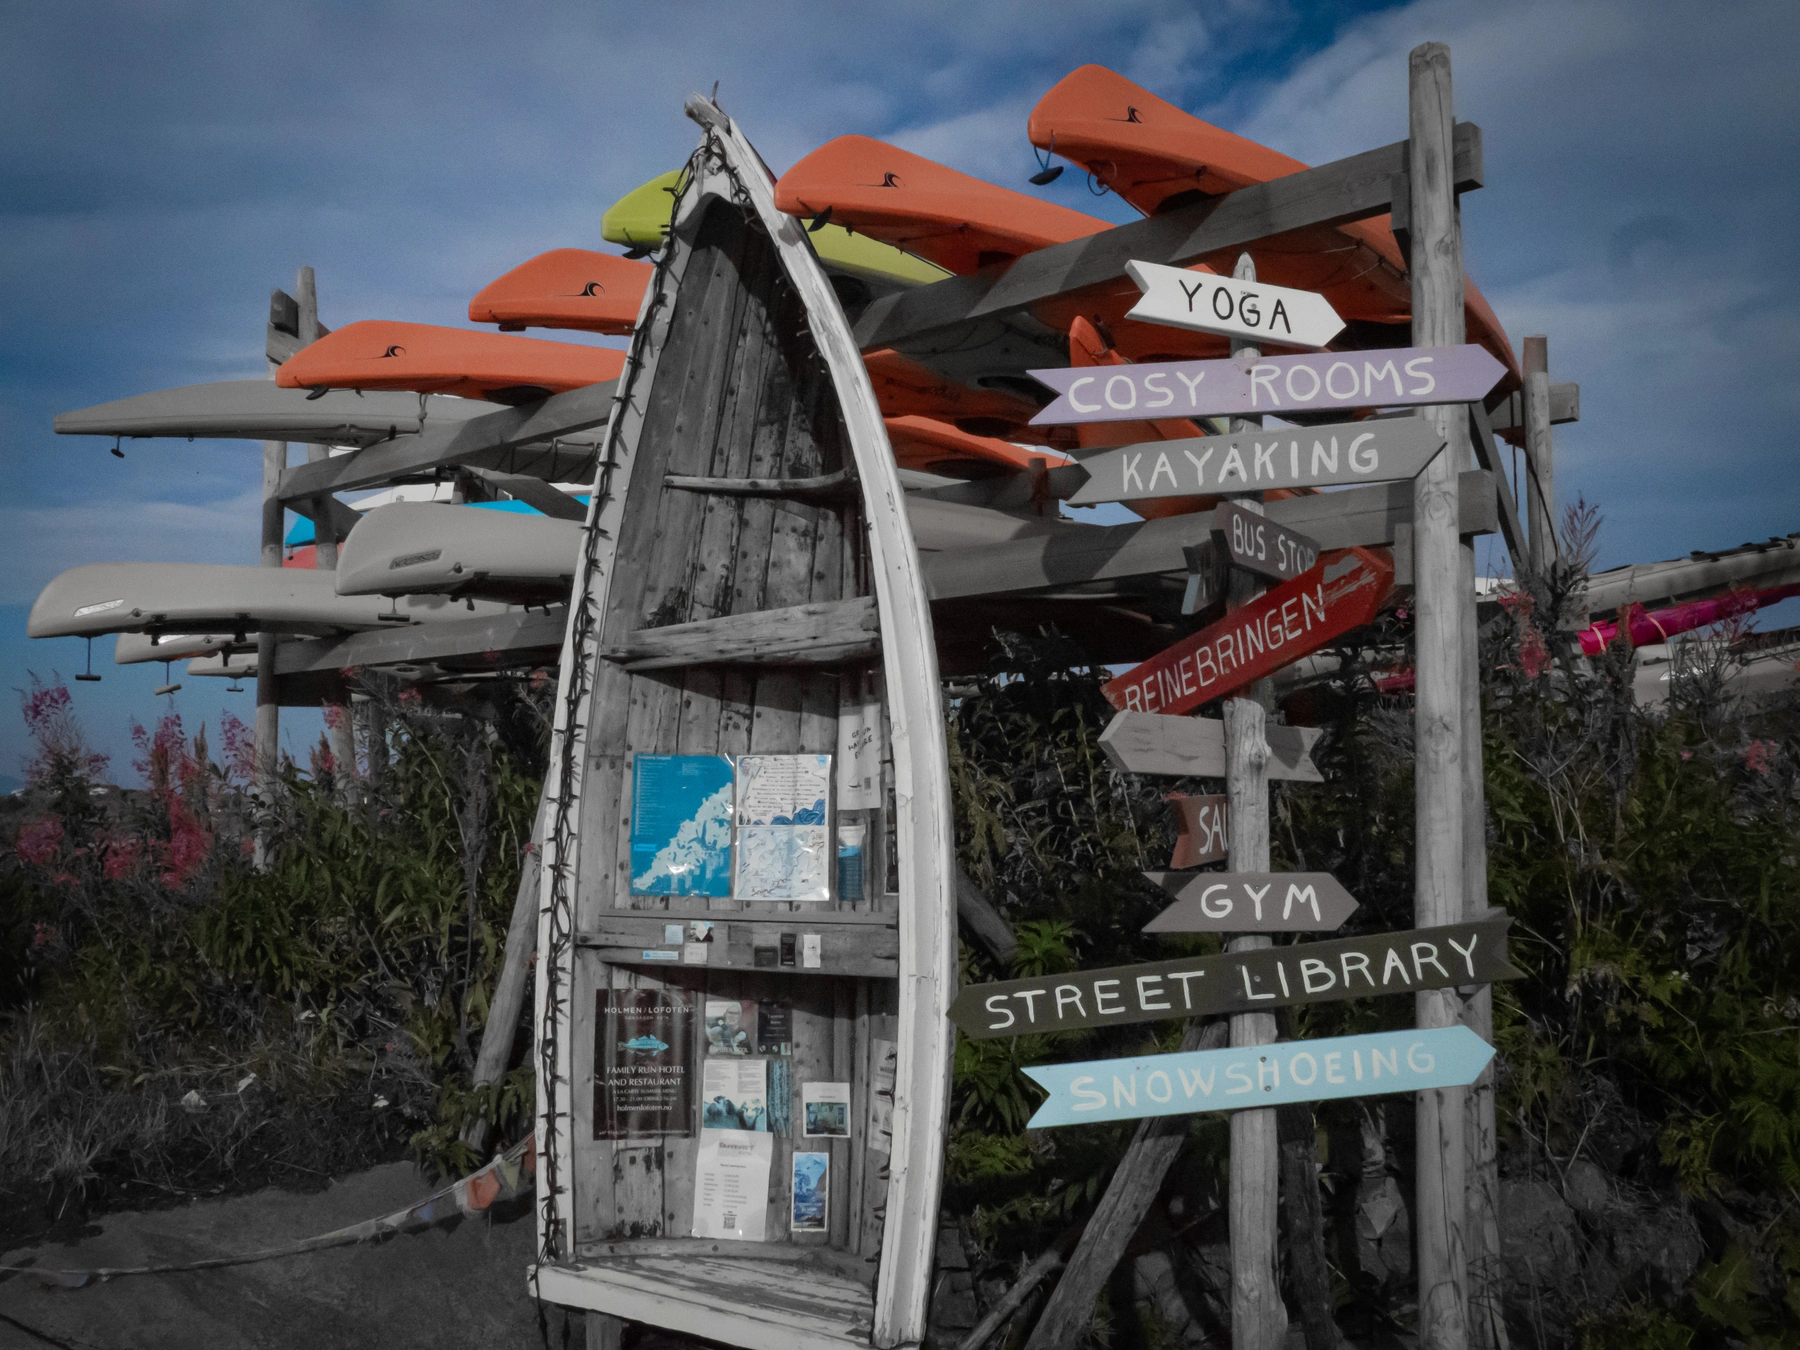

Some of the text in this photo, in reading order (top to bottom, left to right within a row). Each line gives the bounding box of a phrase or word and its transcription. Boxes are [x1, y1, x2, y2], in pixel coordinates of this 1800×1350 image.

[1179, 279, 1291, 334] YOGA
[1068, 357, 1435, 413] COSY ROOMS
[1121, 432, 1379, 494] KAYAKING
[1233, 513, 1266, 561] BUS
[1124, 584, 1326, 715] REINEBRINGEN
[1201, 882, 1322, 922] GYM
[985, 934, 1479, 1030] STREET LIBRARY
[606, 1065, 685, 1074] FAMILY RUN HOTEL
[607, 1077, 682, 1087] AND RESTAURANT
[1069, 1041, 1435, 1112] SNOWSHOEING
[616, 1103, 673, 1112] holmenlofoten.no
